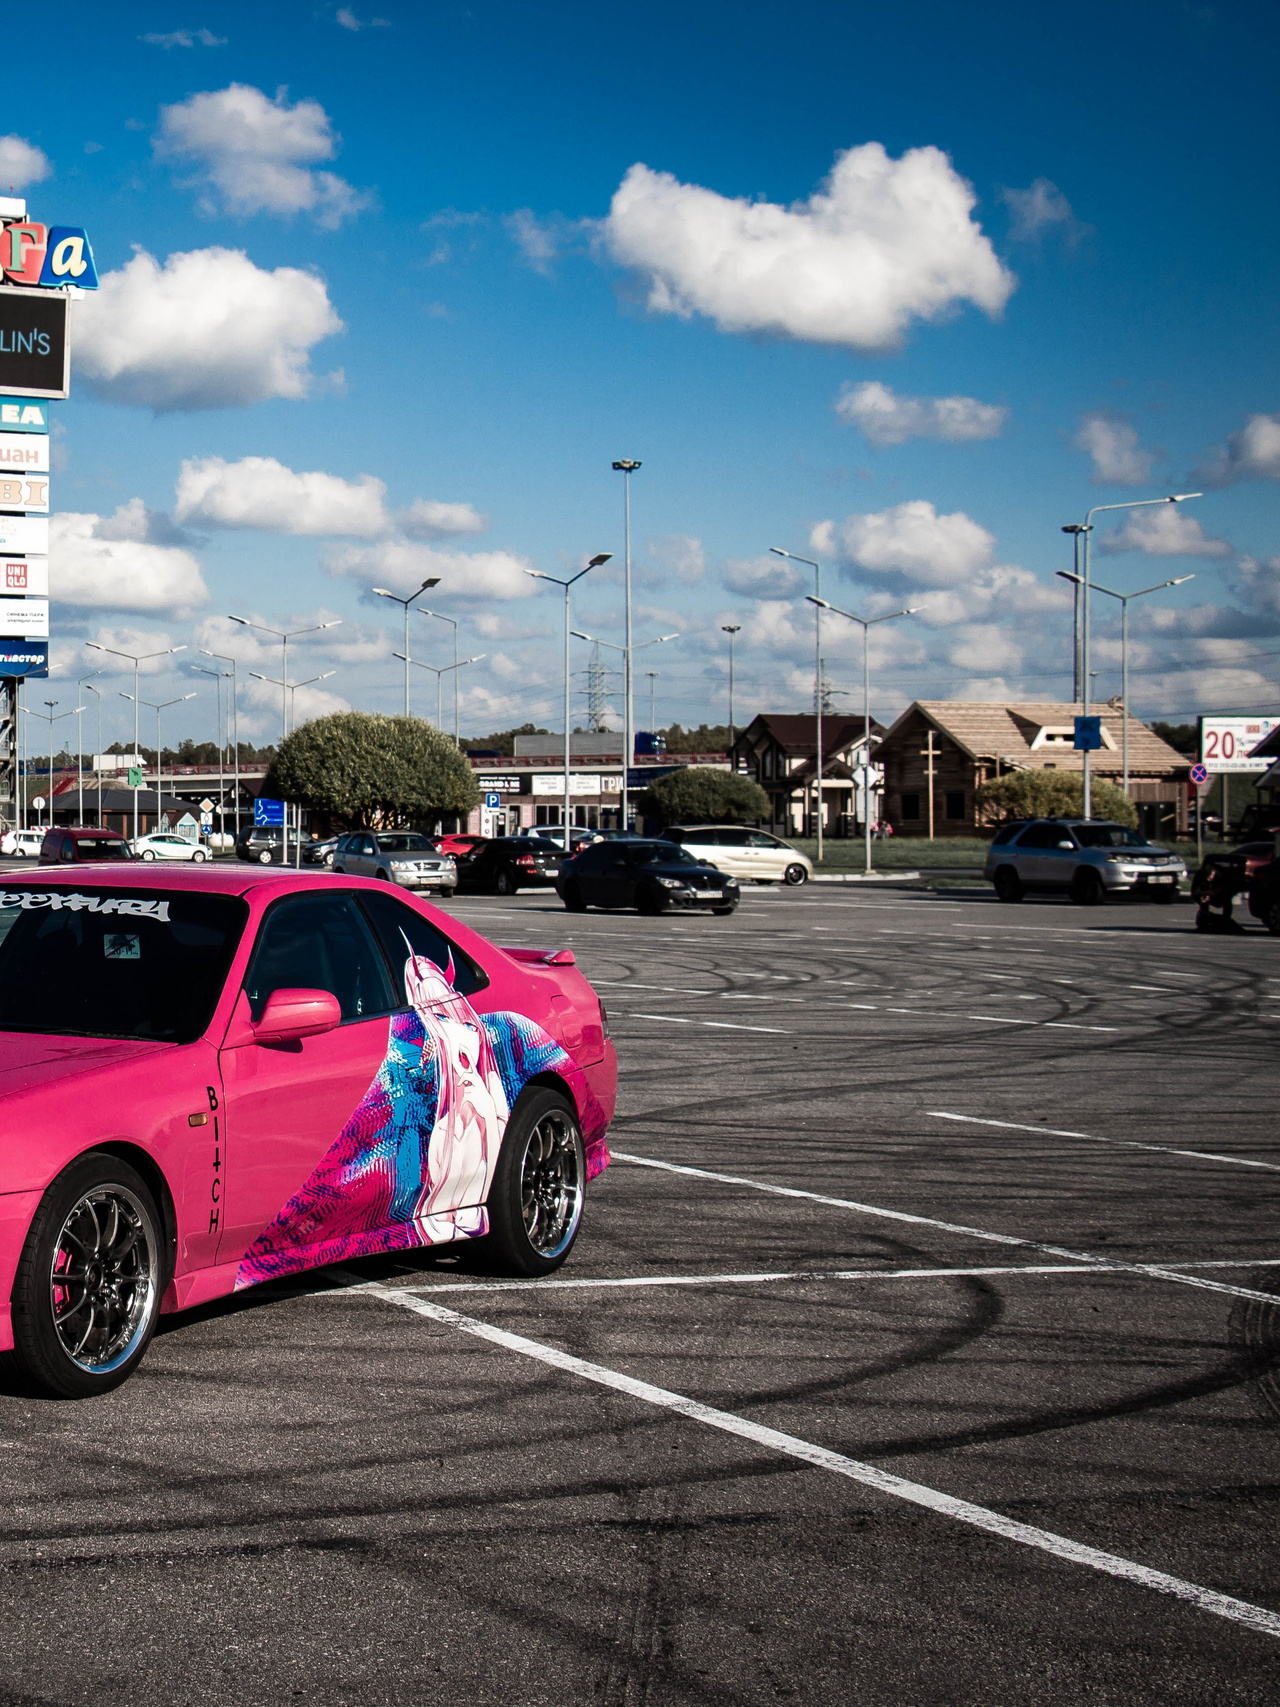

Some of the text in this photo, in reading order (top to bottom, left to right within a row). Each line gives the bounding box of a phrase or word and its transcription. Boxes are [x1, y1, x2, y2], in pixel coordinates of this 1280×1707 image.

[7, 565, 25, 576] UNI
[7, 576, 26, 587] QLO
[1204, 731, 1235, 759] 20
[489, 795, 498, 807] P
